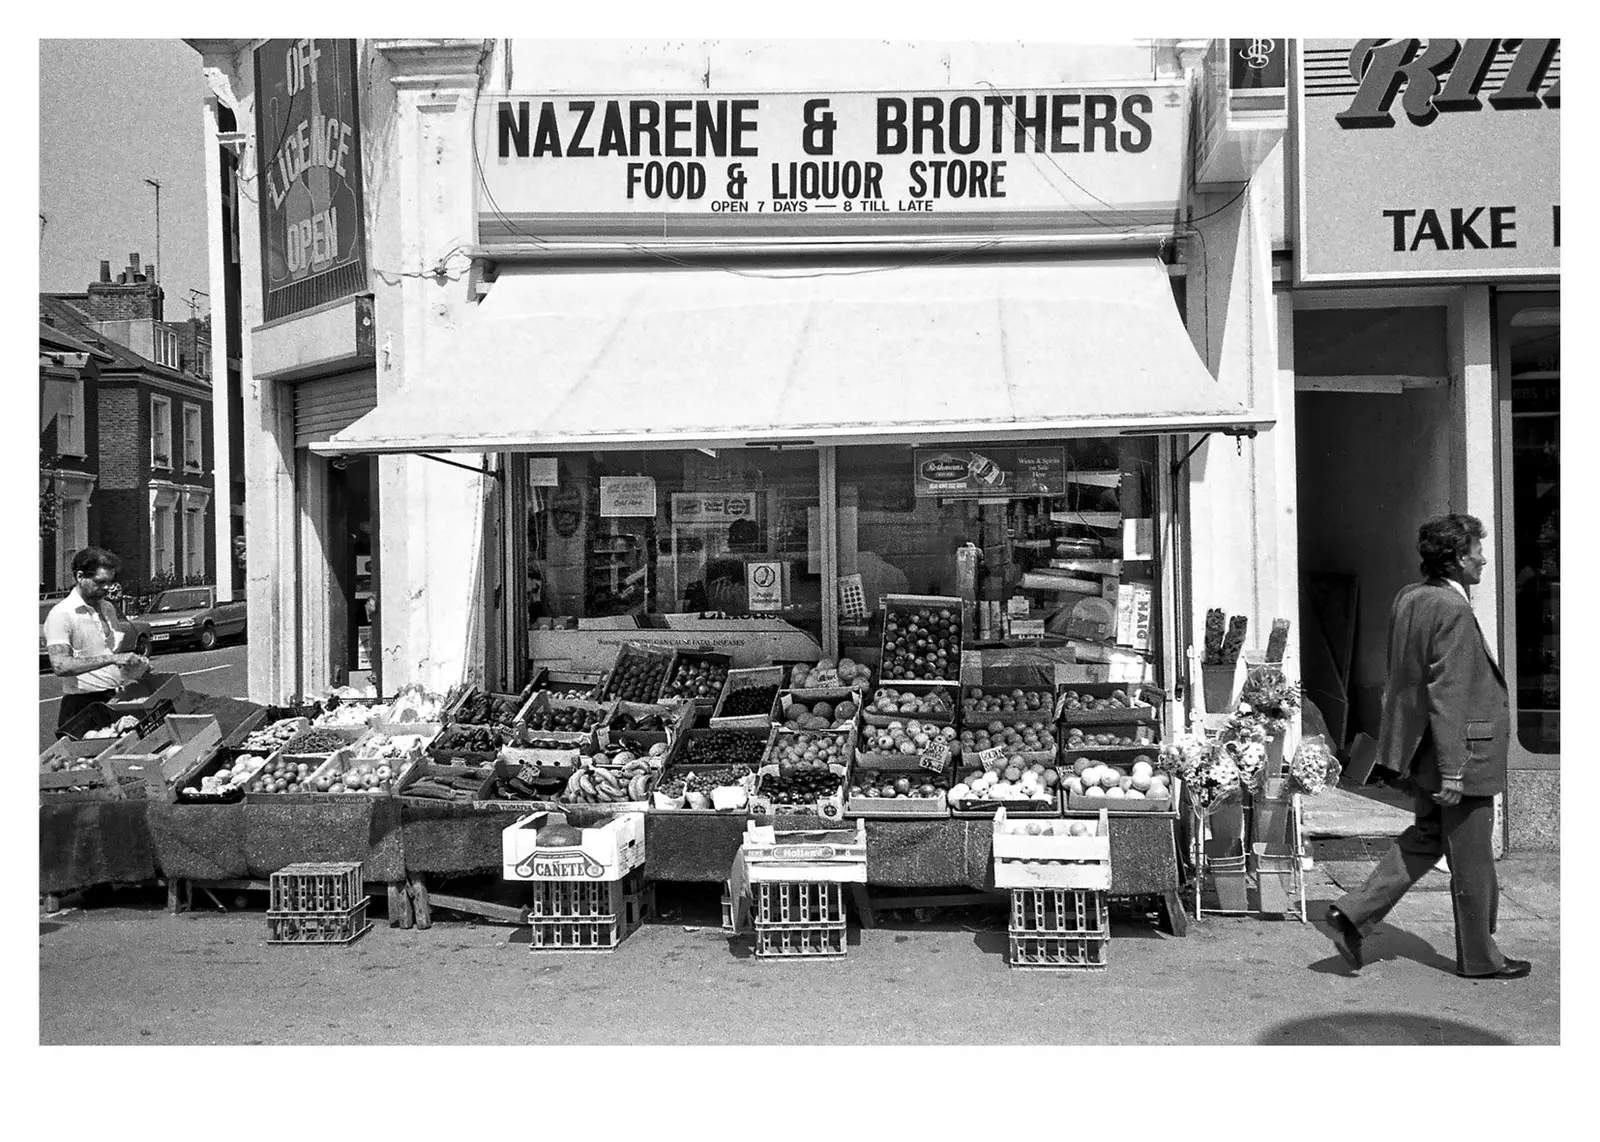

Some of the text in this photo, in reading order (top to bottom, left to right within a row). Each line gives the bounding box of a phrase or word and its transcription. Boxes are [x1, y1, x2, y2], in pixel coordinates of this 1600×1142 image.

[286, 38, 320, 97] OFF
[1335, 38, 1560, 130] RIT
[498, 93, 1153, 158] NAZARENE & BROTHERS
[268, 115, 352, 211] LICENCE
[626, 159, 1007, 200] FOOD & LIQUOR STORE
[710, 200, 749, 213] OPEN
[757, 201, 765, 212] 7
[773, 200, 808, 213] DAYS
[843, 200, 852, 212] 8
[861, 200, 890, 212] TILL
[898, 200, 934, 212] LATE
[1382, 206, 1517, 252] TAKE
[287, 206, 338, 273] OPEN
[1137, 601, 1149, 639] HAIG
[535, 860, 585, 877] CAÑETE
[783, 847, 823, 857] Holland
